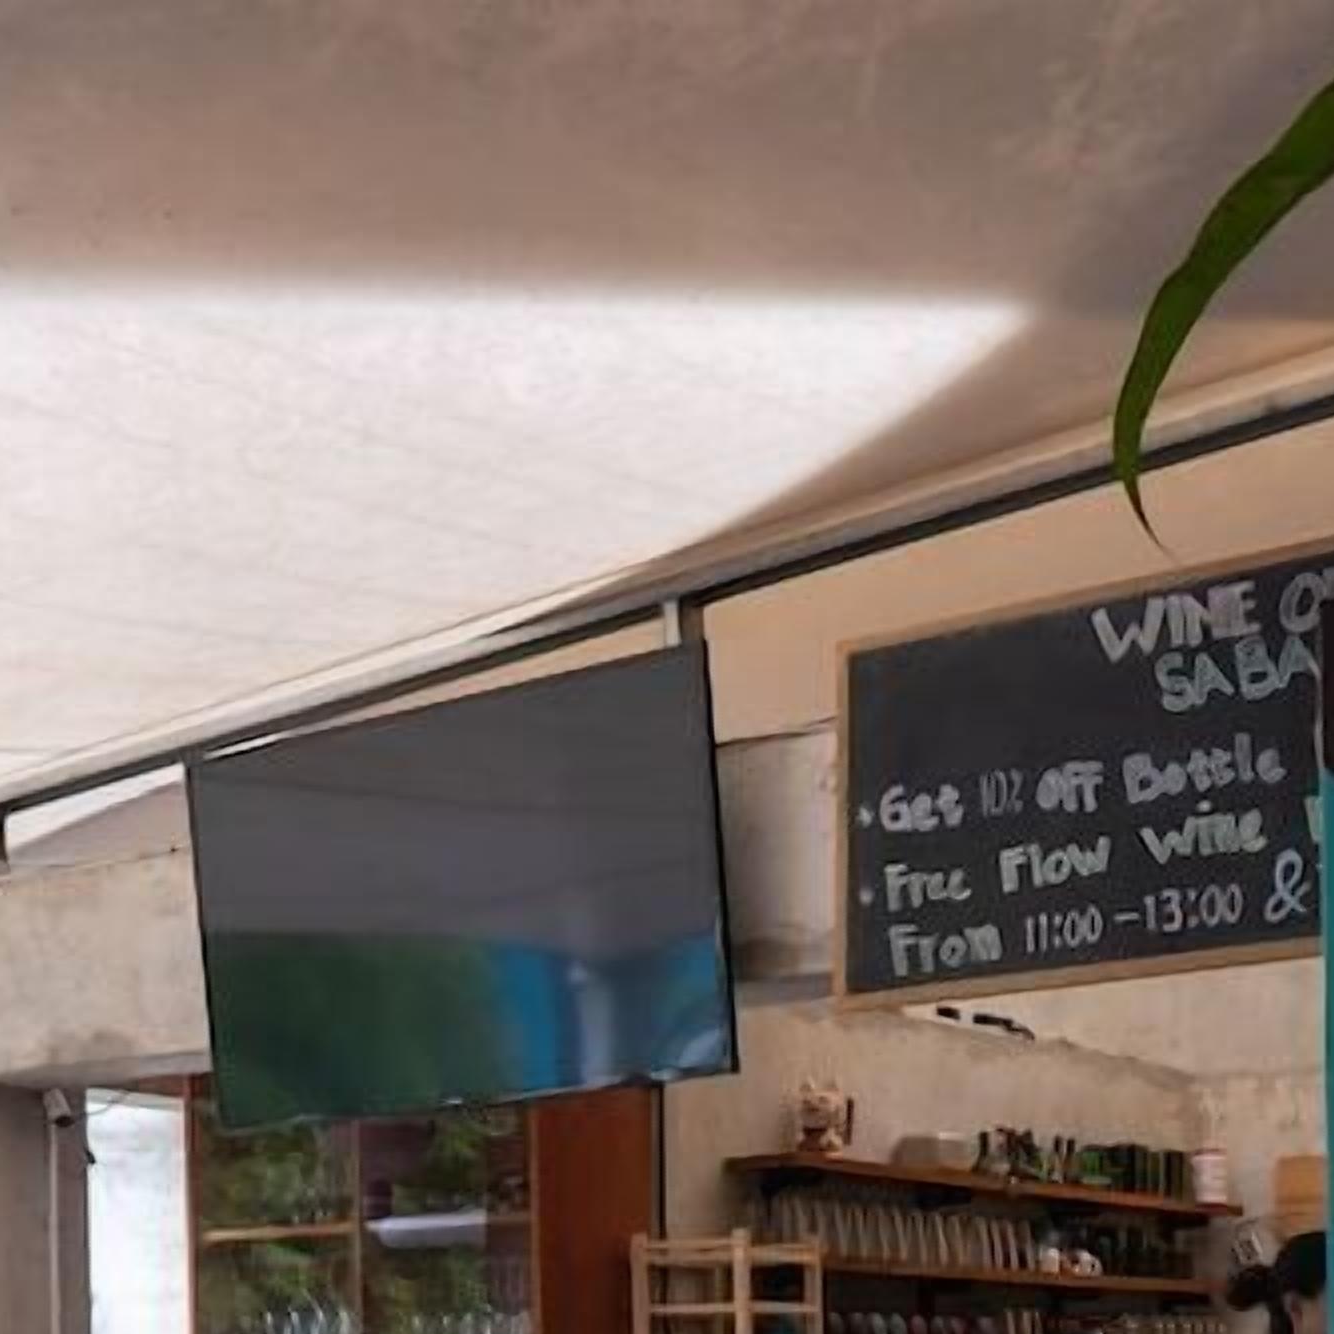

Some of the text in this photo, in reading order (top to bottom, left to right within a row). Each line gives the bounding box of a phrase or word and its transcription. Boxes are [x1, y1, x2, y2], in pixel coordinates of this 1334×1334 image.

[1091, 580, 1262, 663] WINE
[879, 784, 964, 832] Get
[1123, 732, 1287, 804] Bottle
[884, 863, 972, 912] Free
[1264, 849, 1313, 923] &
